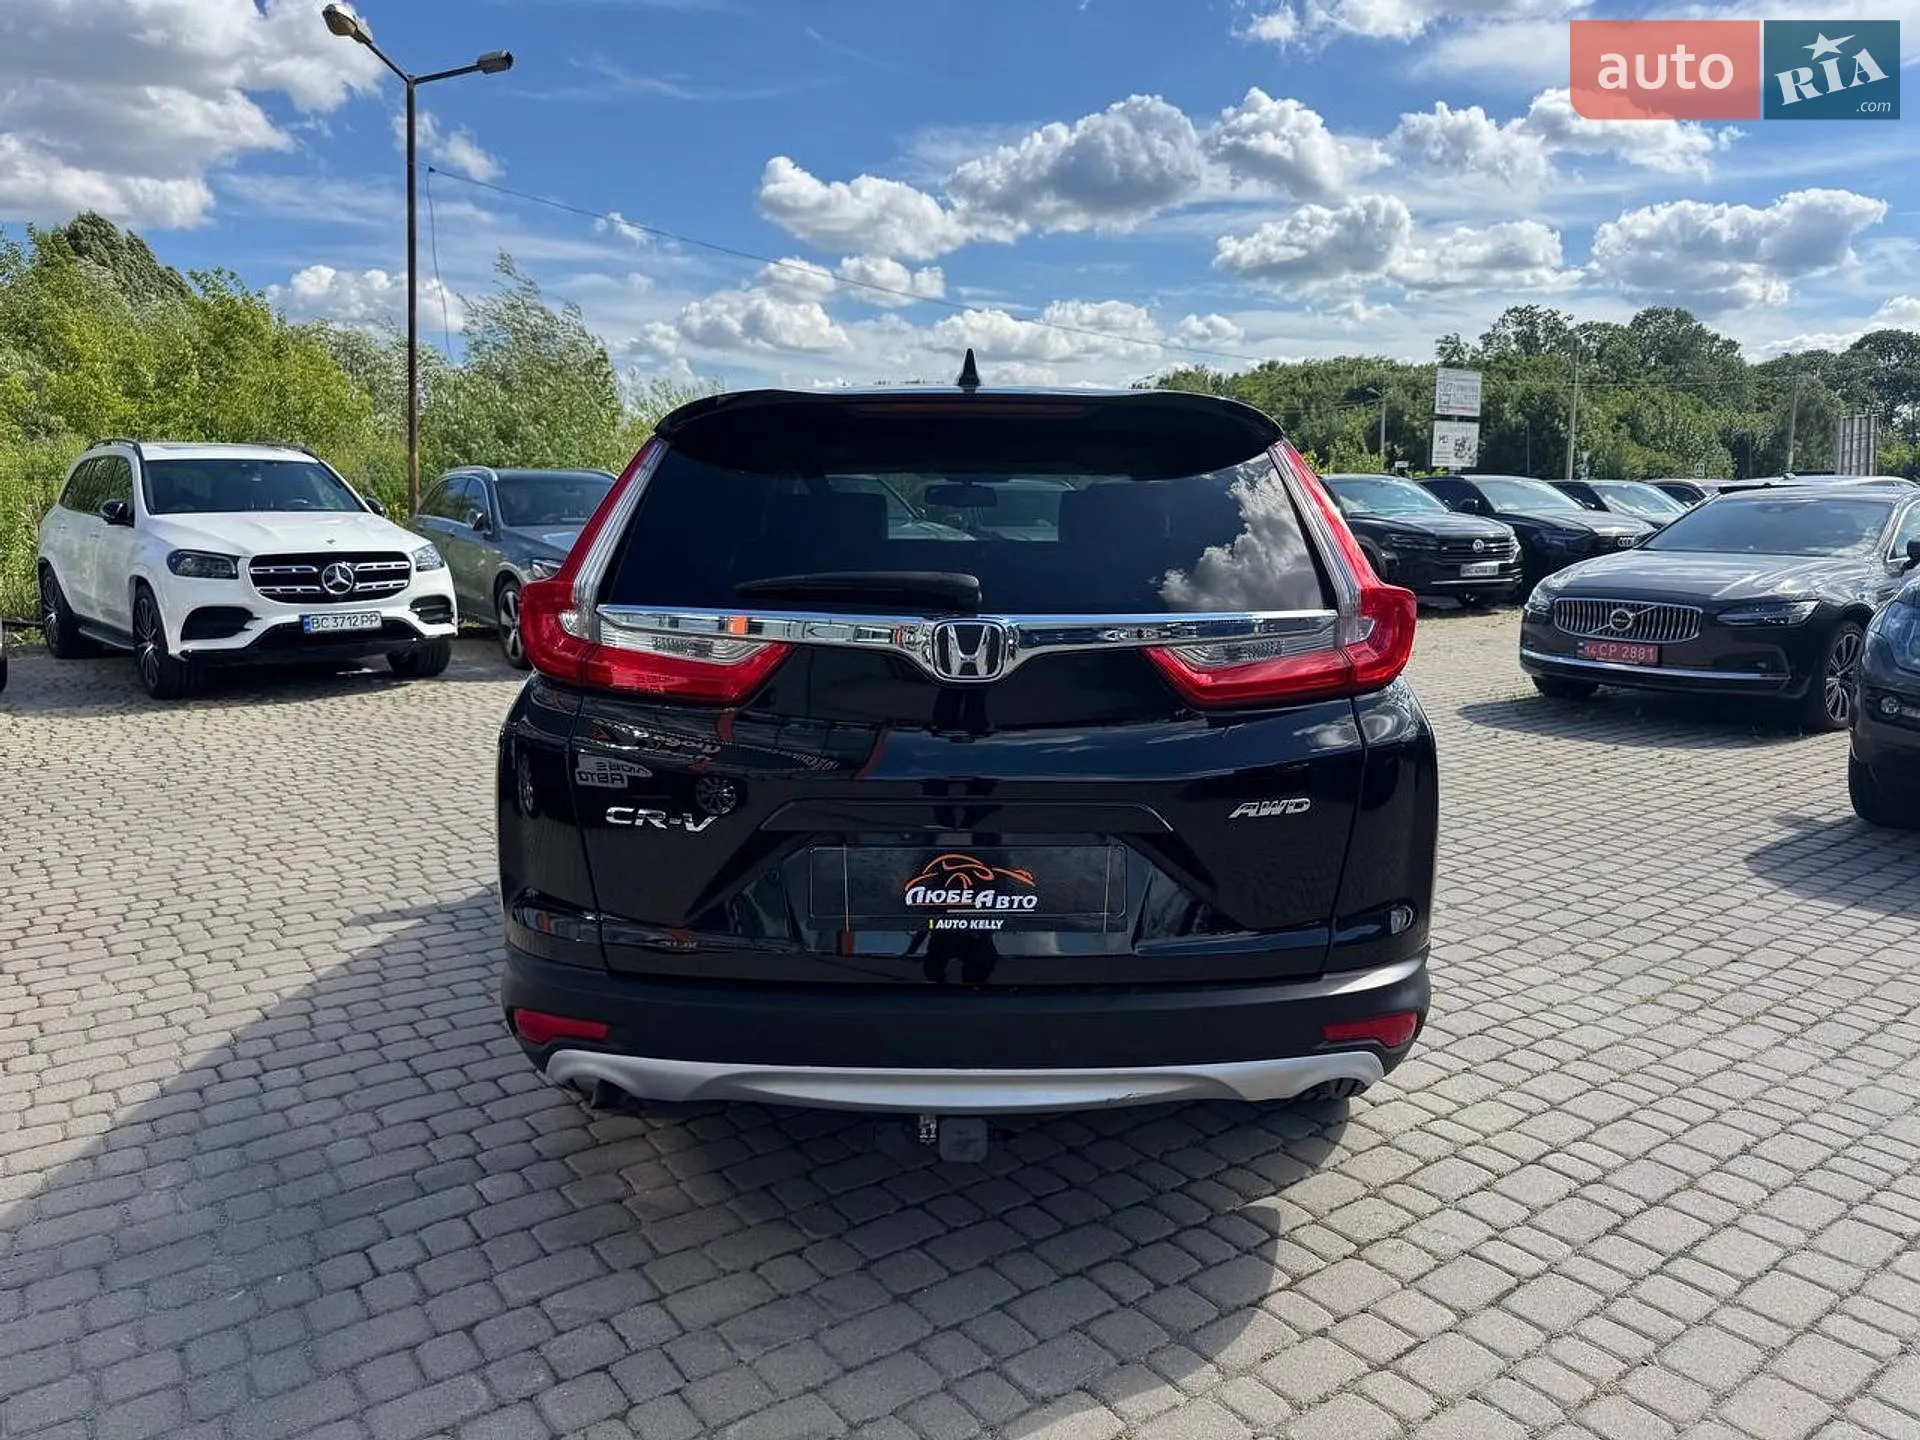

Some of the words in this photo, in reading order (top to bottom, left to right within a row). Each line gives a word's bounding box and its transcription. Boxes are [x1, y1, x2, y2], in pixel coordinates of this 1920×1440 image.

[311, 616, 329, 629] BC
[331, 615, 359, 628] 3712
[360, 614, 378, 626] PP
[1599, 644, 1617, 657] CP
[1621, 646, 1654, 660] 2881
[1228, 798, 1311, 819] AWD
[606, 806, 718, 833] CR-V
[935, 919, 968, 930] AUTO
[970, 919, 1004, 930] KELLY
